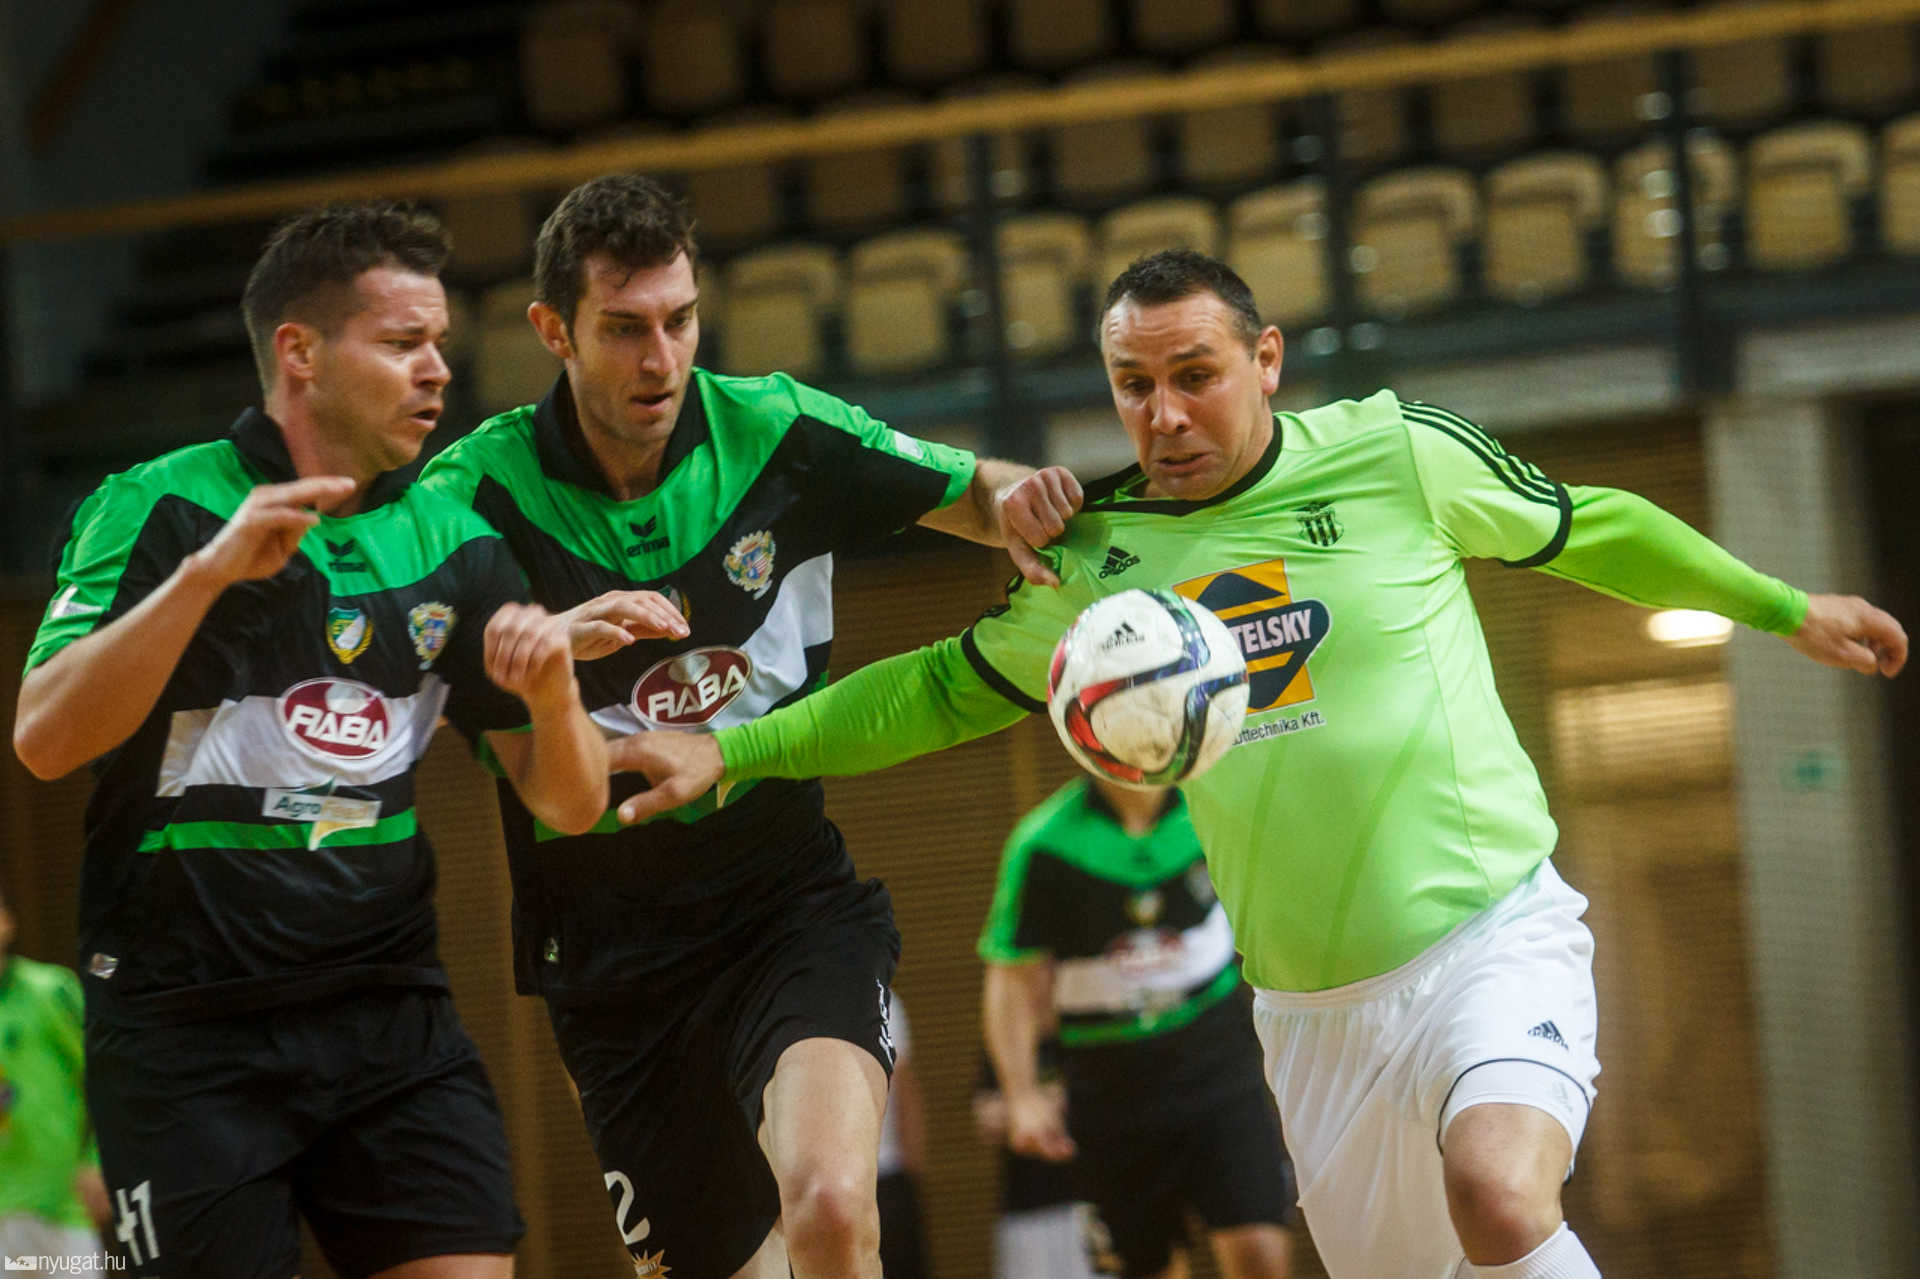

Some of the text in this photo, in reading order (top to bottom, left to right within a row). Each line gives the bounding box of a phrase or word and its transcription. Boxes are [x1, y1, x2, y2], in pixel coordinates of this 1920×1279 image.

[1098, 554, 1141, 580] adidas
[1227, 608, 1313, 654] TELSKY
[603, 1170, 651, 1246] 2
